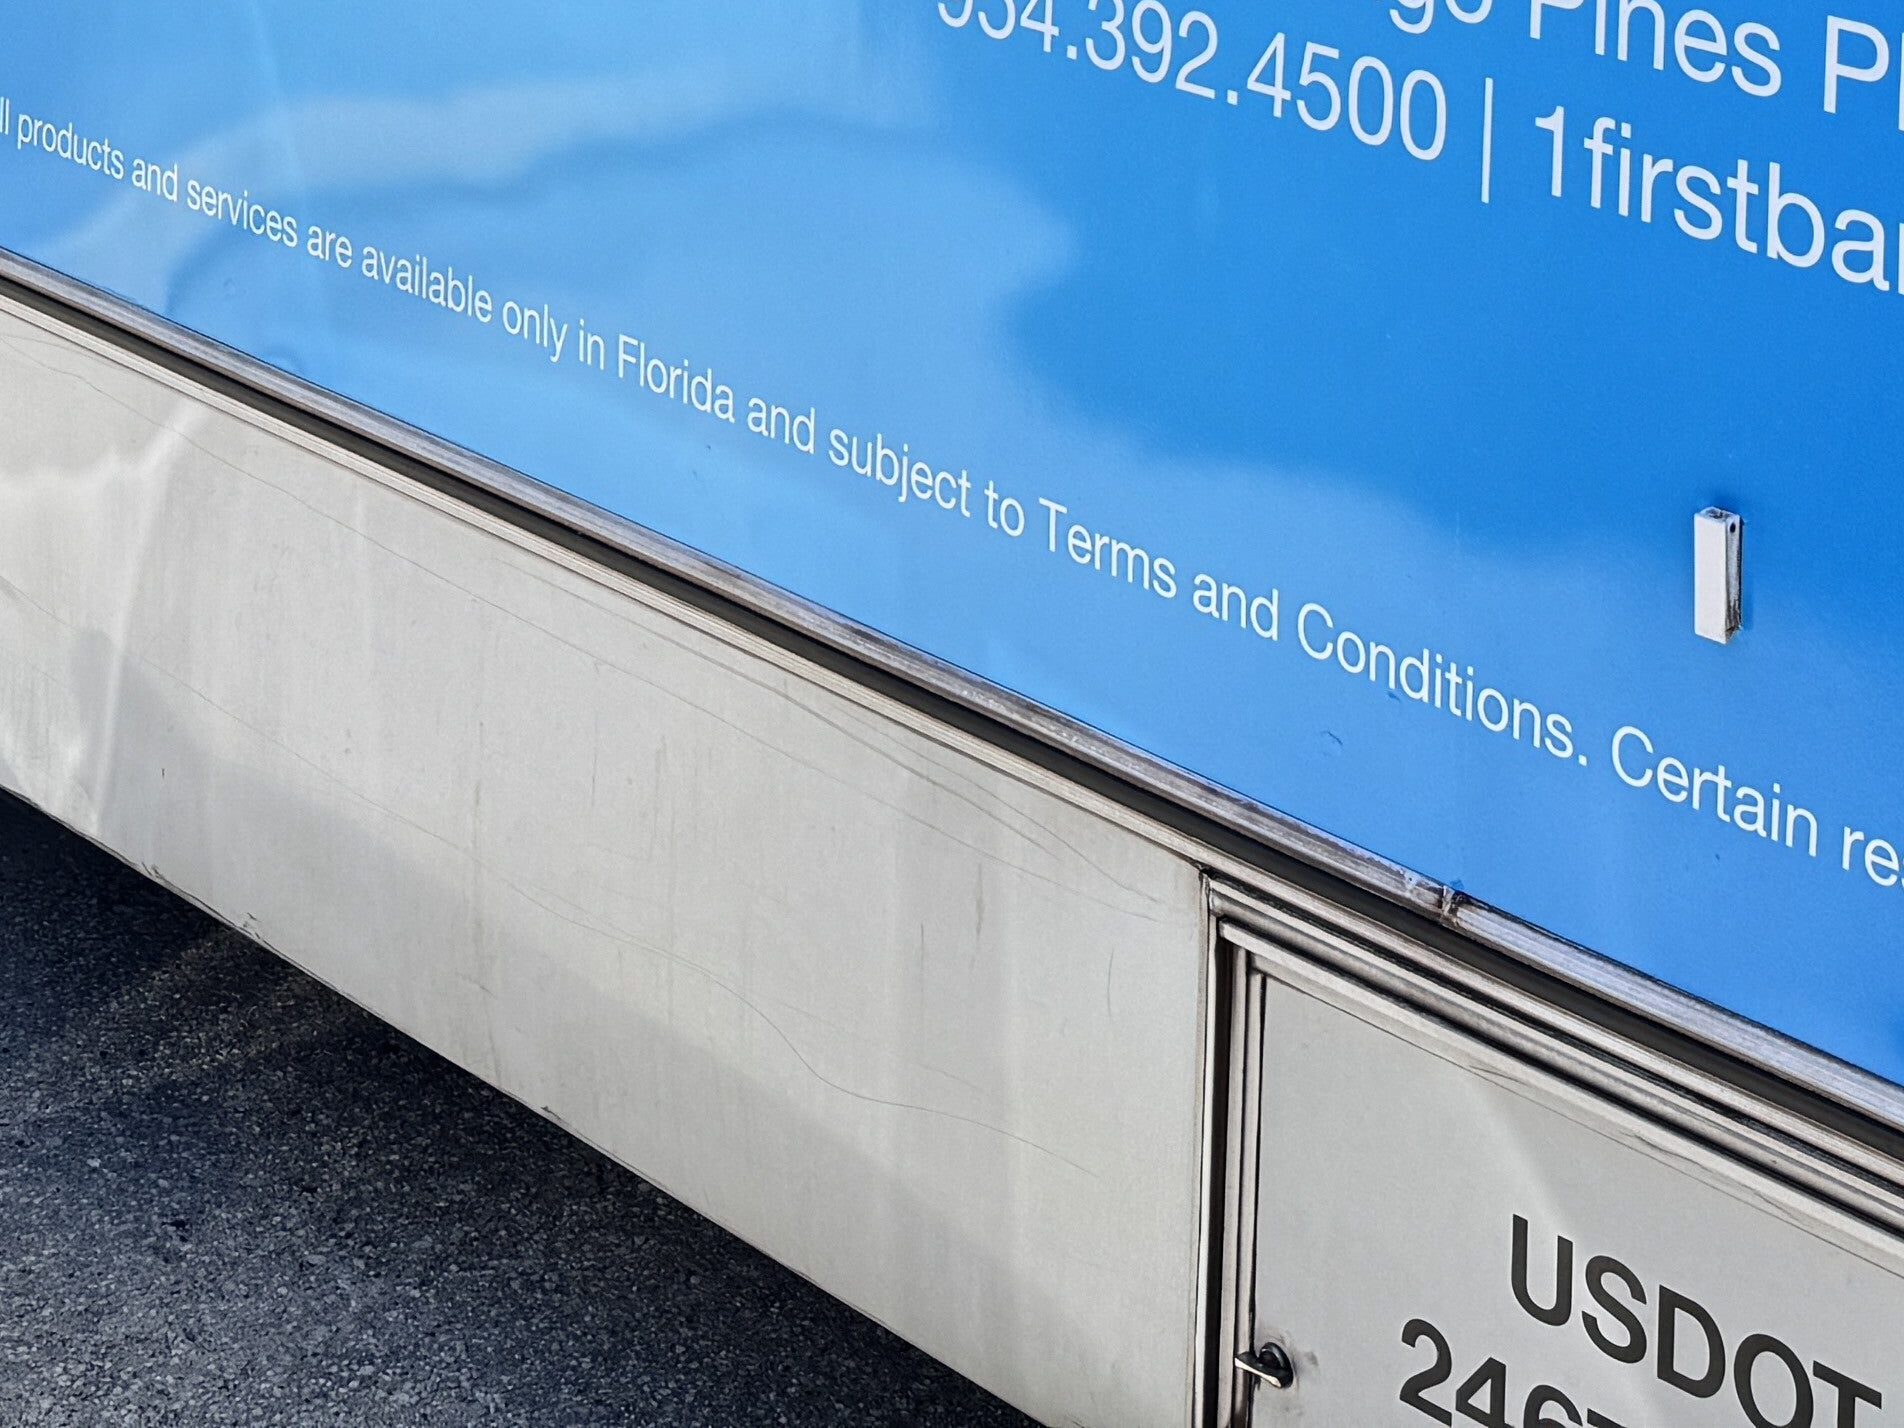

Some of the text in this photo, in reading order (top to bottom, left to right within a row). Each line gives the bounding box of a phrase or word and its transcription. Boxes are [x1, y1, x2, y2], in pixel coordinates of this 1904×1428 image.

[16, 112, 124, 180] products
[131, 154, 179, 203] and
[186, 178, 298, 248] services
[306, 224, 353, 268] are
[361, 245, 493, 323] available
[502, 299, 568, 364] only
[578, 329, 605, 371] in
[618, 334, 736, 424] Florida
[747, 396, 815, 454] and
[828, 427, 972, 518] subject
[984, 479, 1026, 538] to
[1038, 497, 1177, 599] Terms
[1192, 572, 1280, 642] and
[1297, 601, 1588, 767] Conditions.
[1610, 724, 1818, 857] Certain
[1510, 1213, 1883, 1428] USDOT
